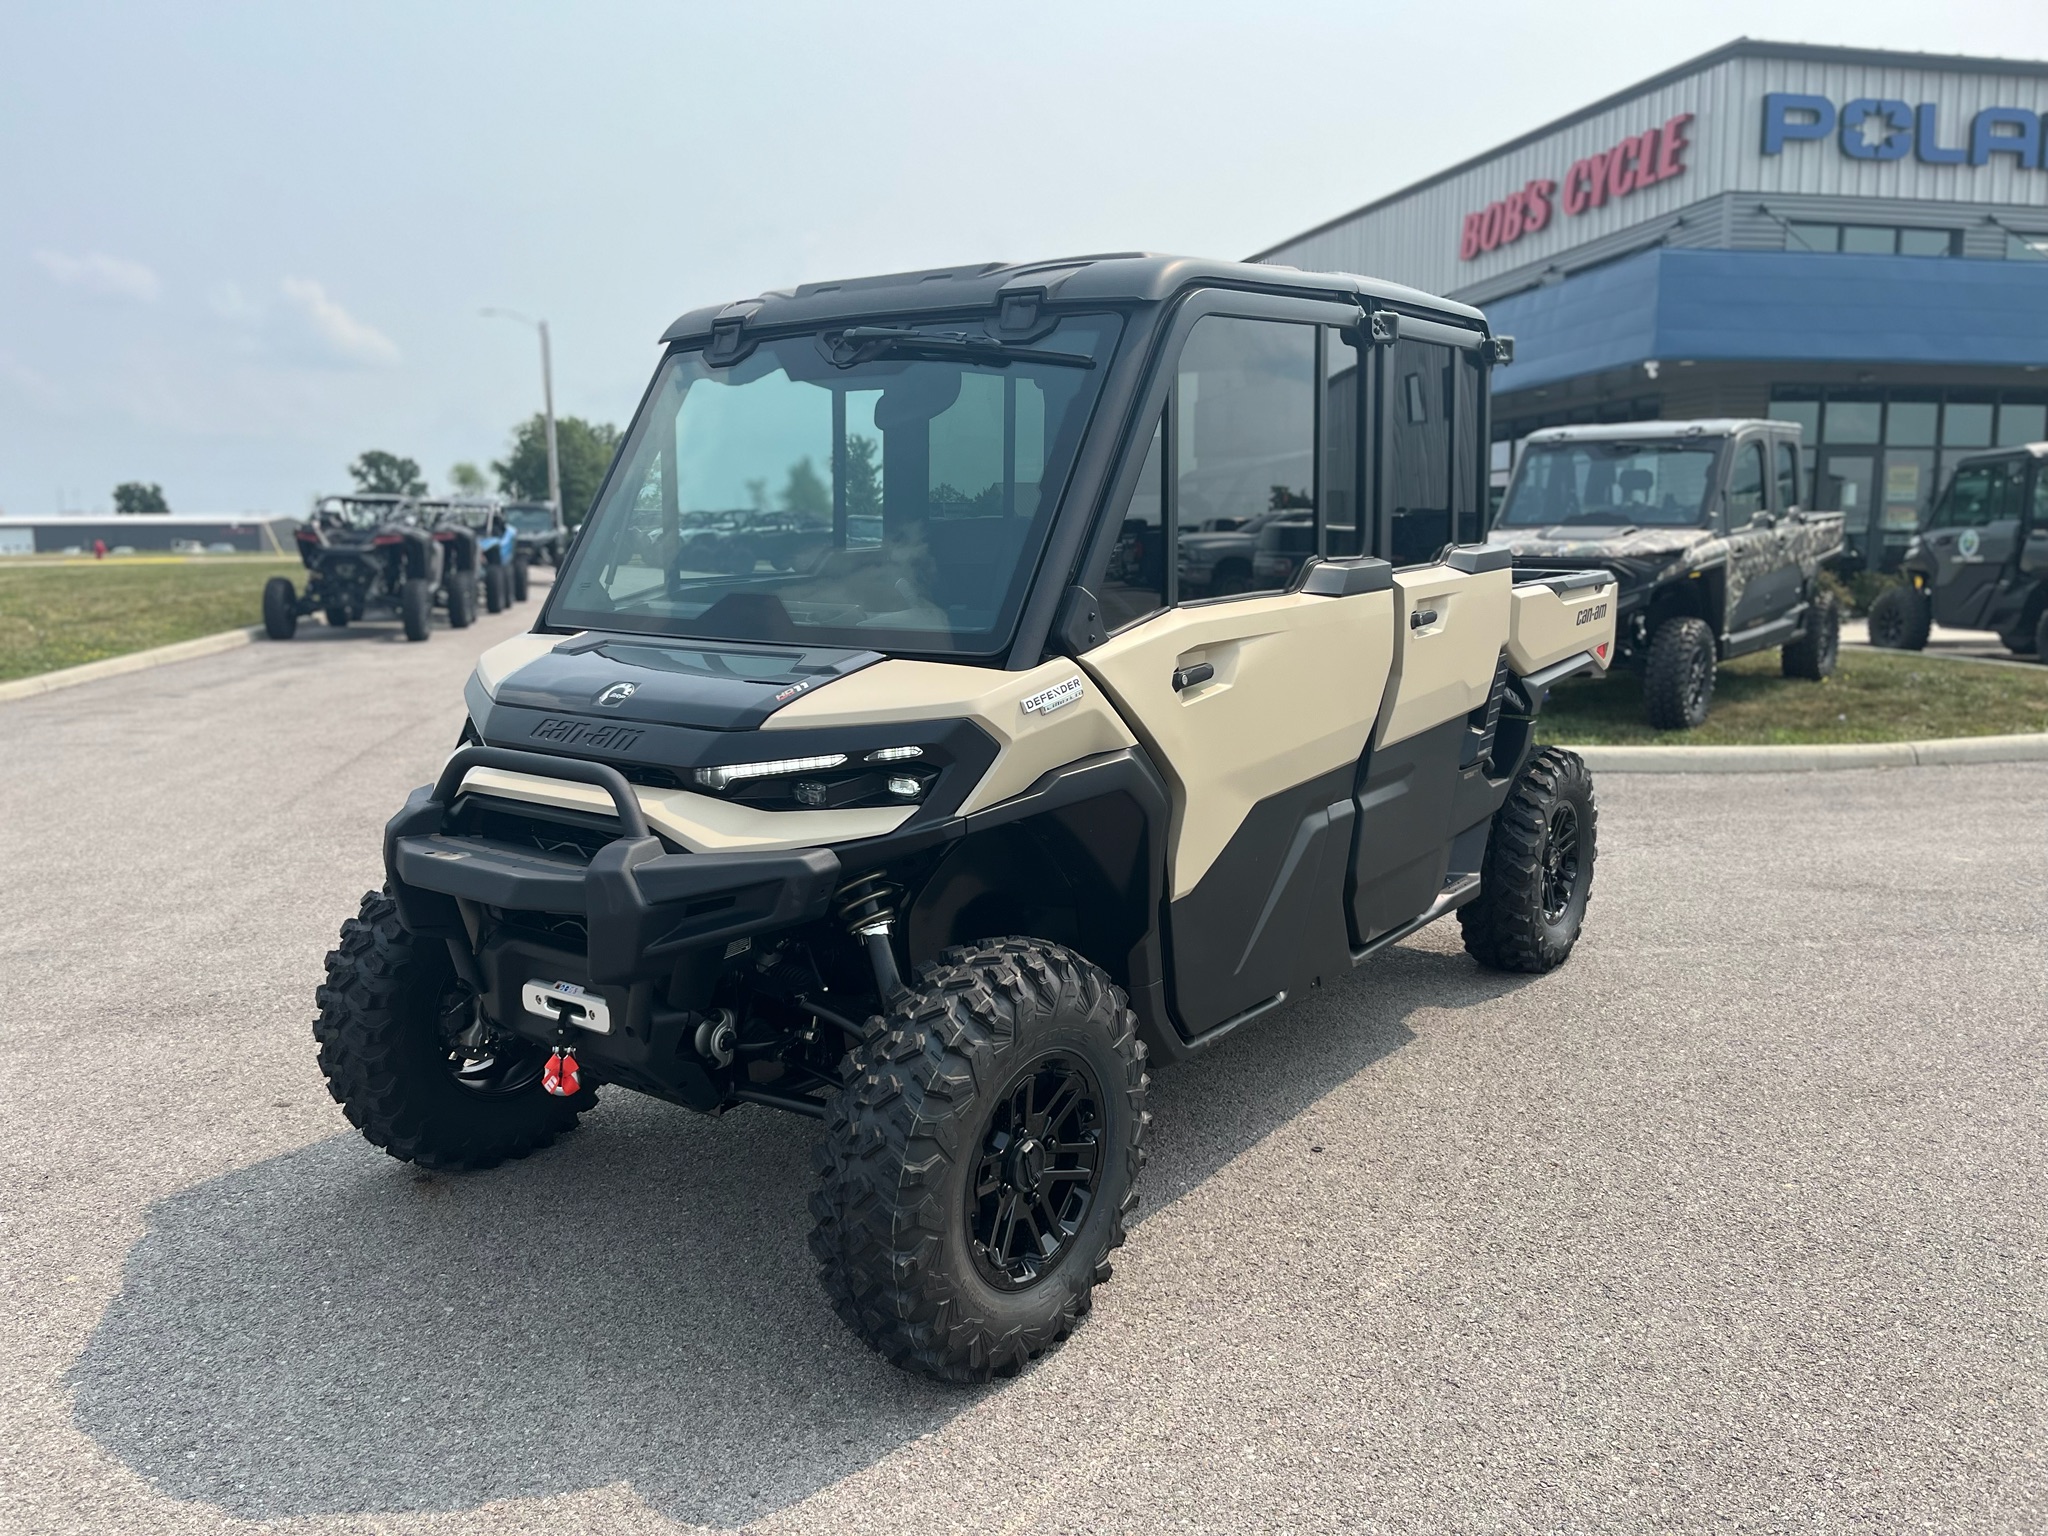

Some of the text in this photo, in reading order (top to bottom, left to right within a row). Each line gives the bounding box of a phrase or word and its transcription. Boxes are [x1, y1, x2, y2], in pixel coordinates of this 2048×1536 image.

[1760, 92, 2048, 171] POLA
[1460, 113, 1695, 262] BOB'S CYCLE
[1576, 603, 1607, 626] can-am
[1025, 678, 1081, 709] DEFENDER
